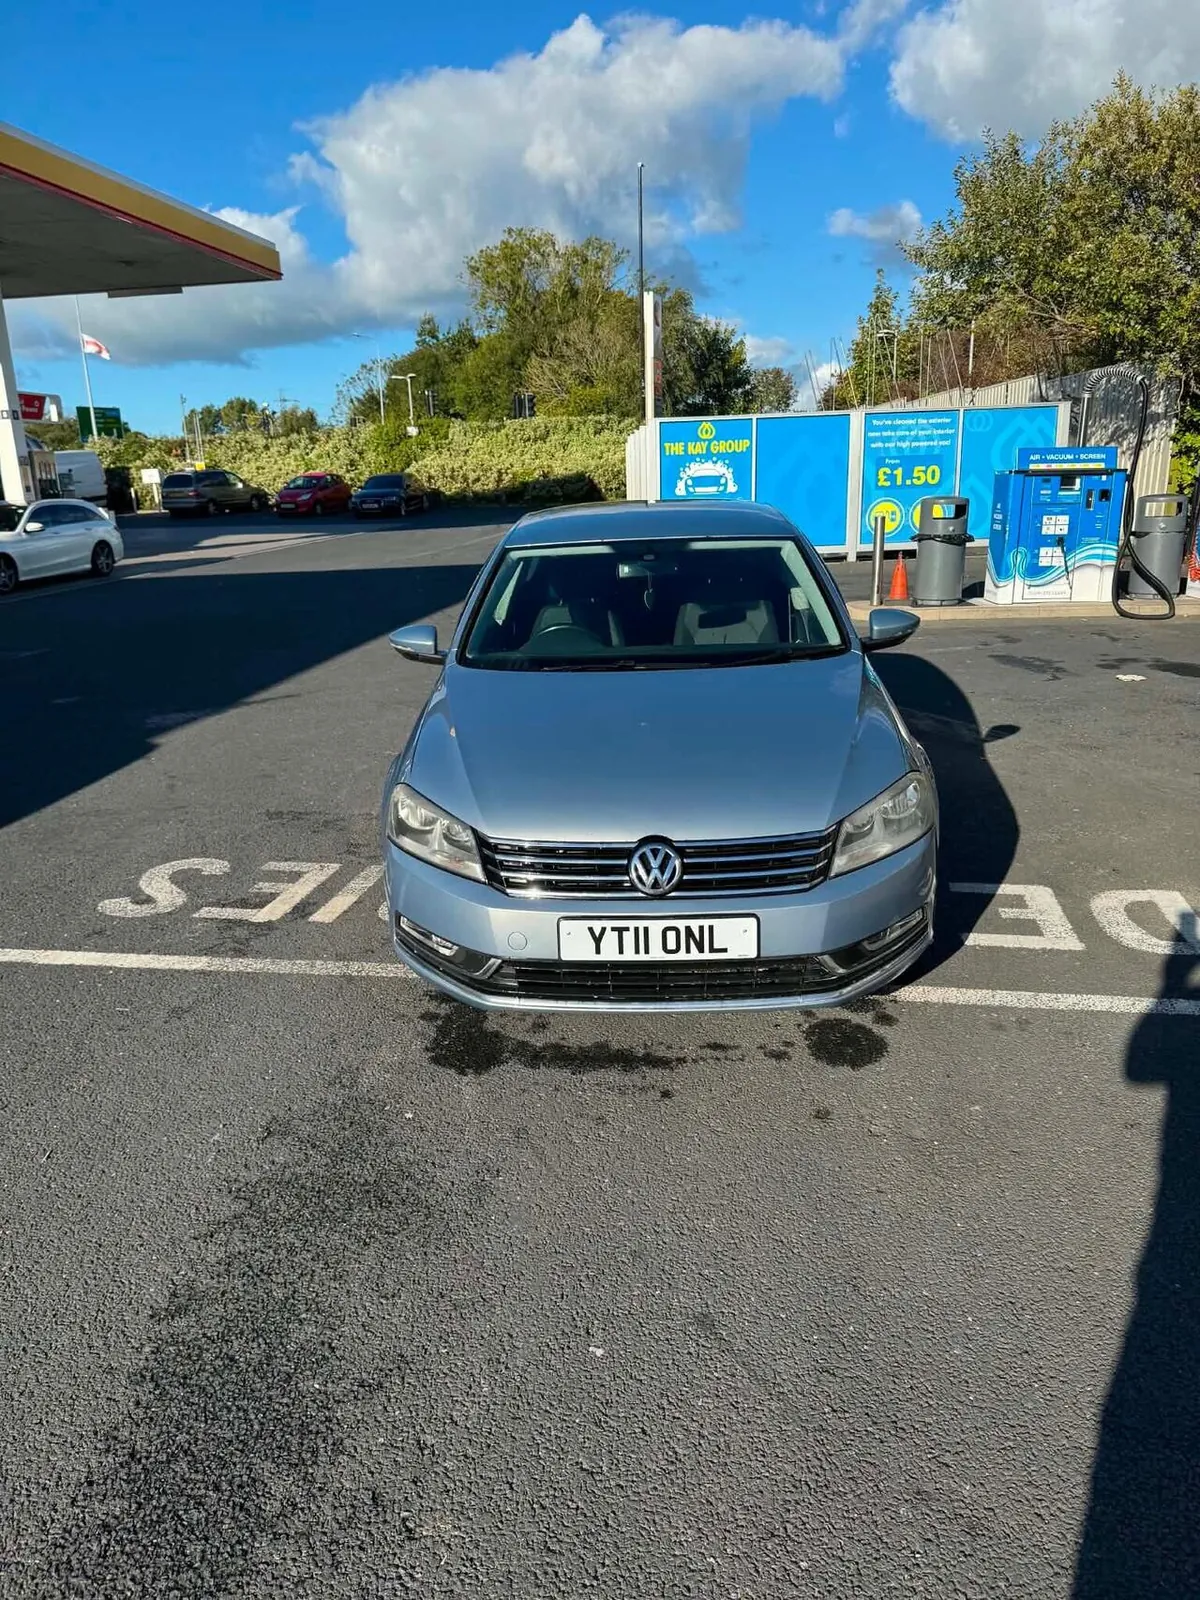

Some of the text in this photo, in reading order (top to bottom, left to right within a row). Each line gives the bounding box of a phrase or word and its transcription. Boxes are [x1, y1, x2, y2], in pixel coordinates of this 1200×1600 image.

[664, 439, 750, 455] THE KAY GROUP
[911, 440, 938, 449] powered
[877, 465, 941, 487] £1.50
[587, 925, 728, 955] YT11 ONL
